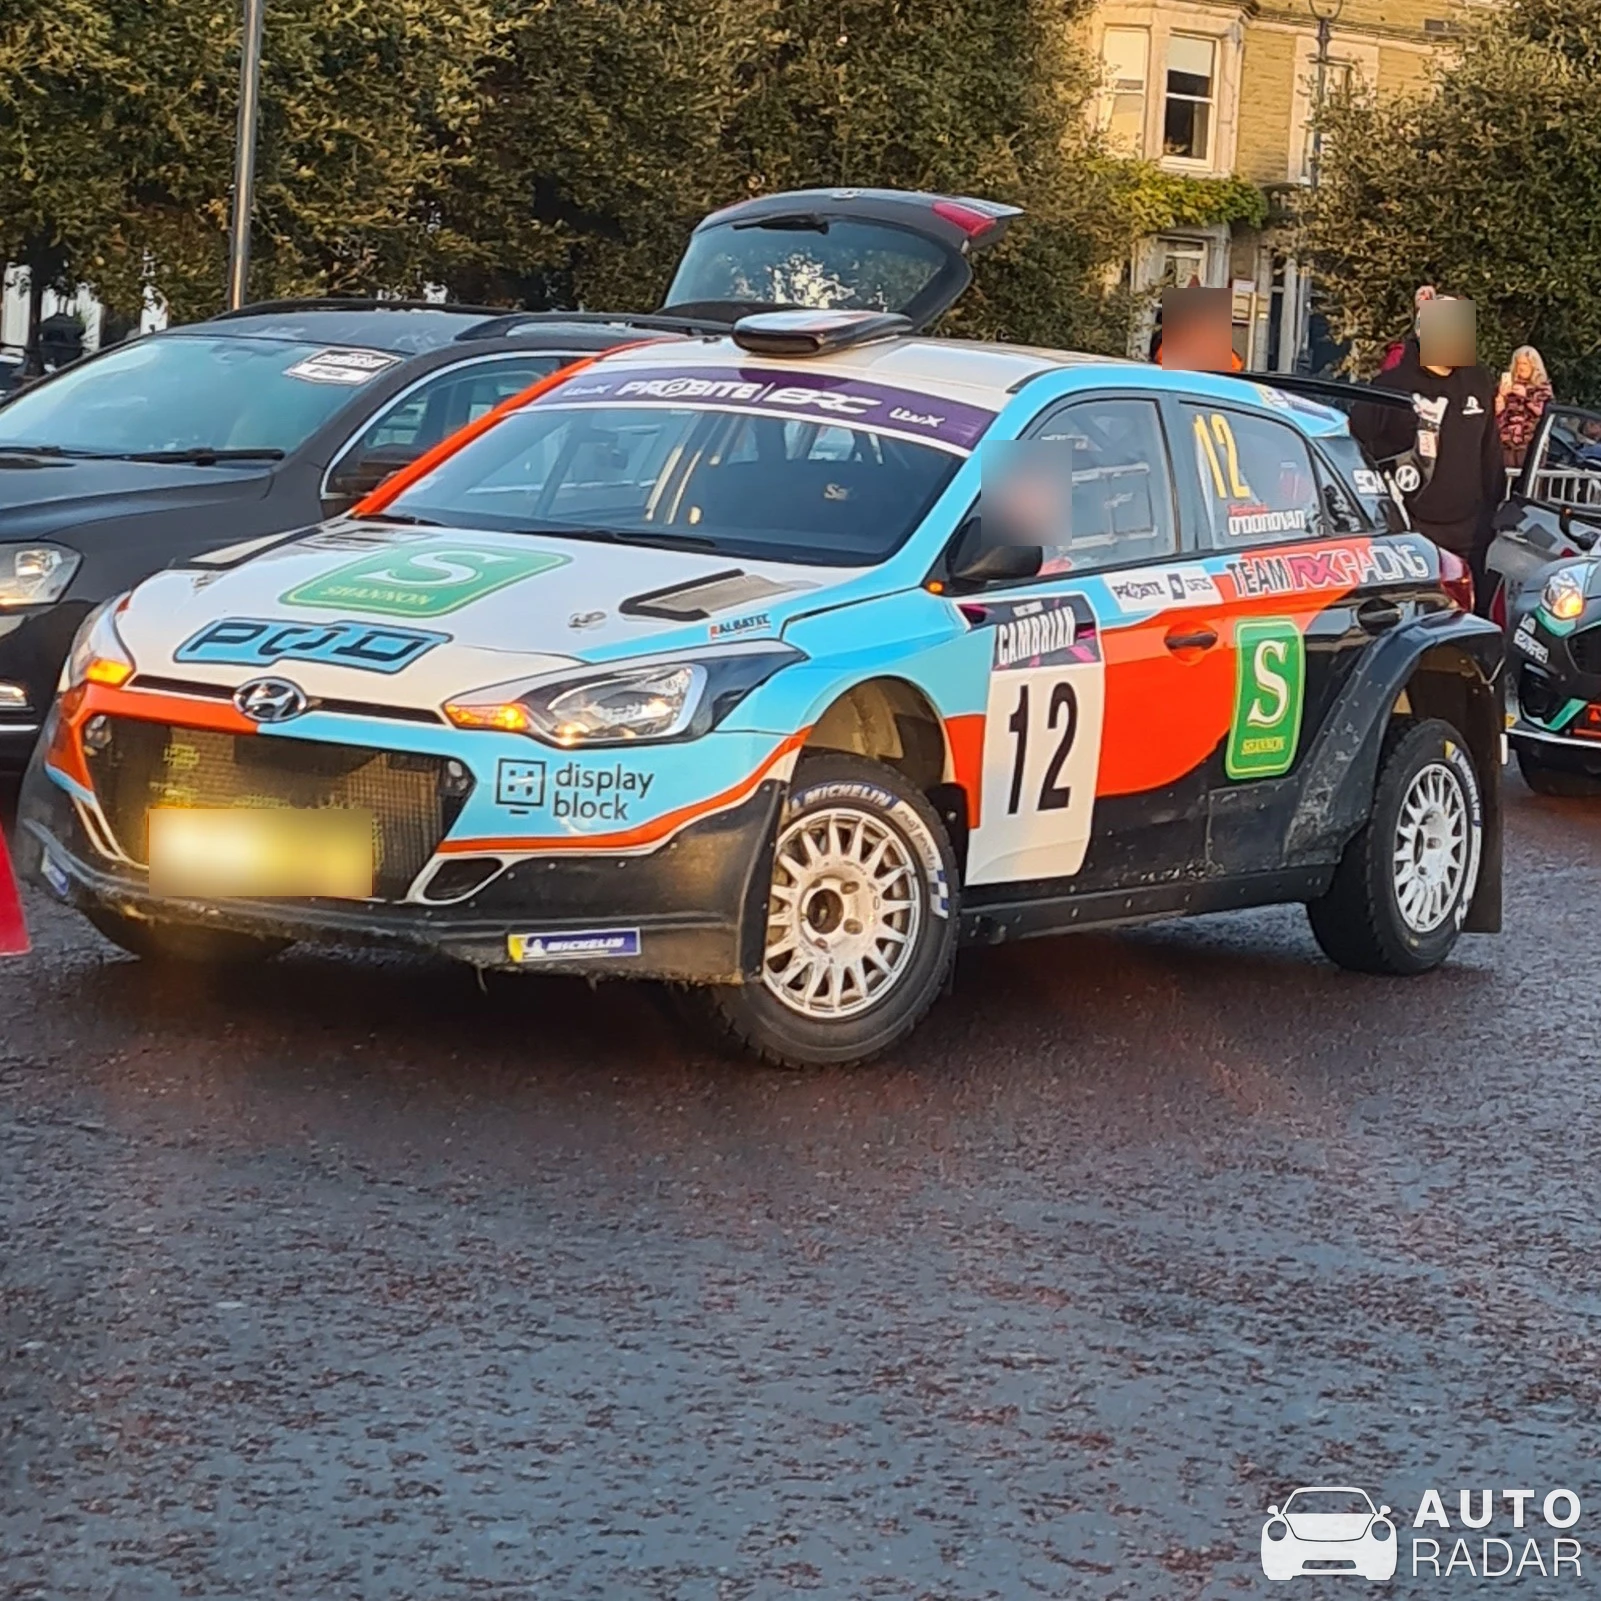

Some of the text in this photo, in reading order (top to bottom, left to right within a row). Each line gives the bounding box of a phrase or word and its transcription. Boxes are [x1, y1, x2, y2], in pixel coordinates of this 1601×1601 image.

[1193, 413, 1251, 499] 12
[1226, 556, 1292, 597] TEAM
[998, 605, 1076, 665] CAMBRIAN
[1007, 681, 1078, 816] 12
[555, 761, 655, 799] display
[804, 783, 893, 808] MICHELIN
[553, 791, 629, 821] block
